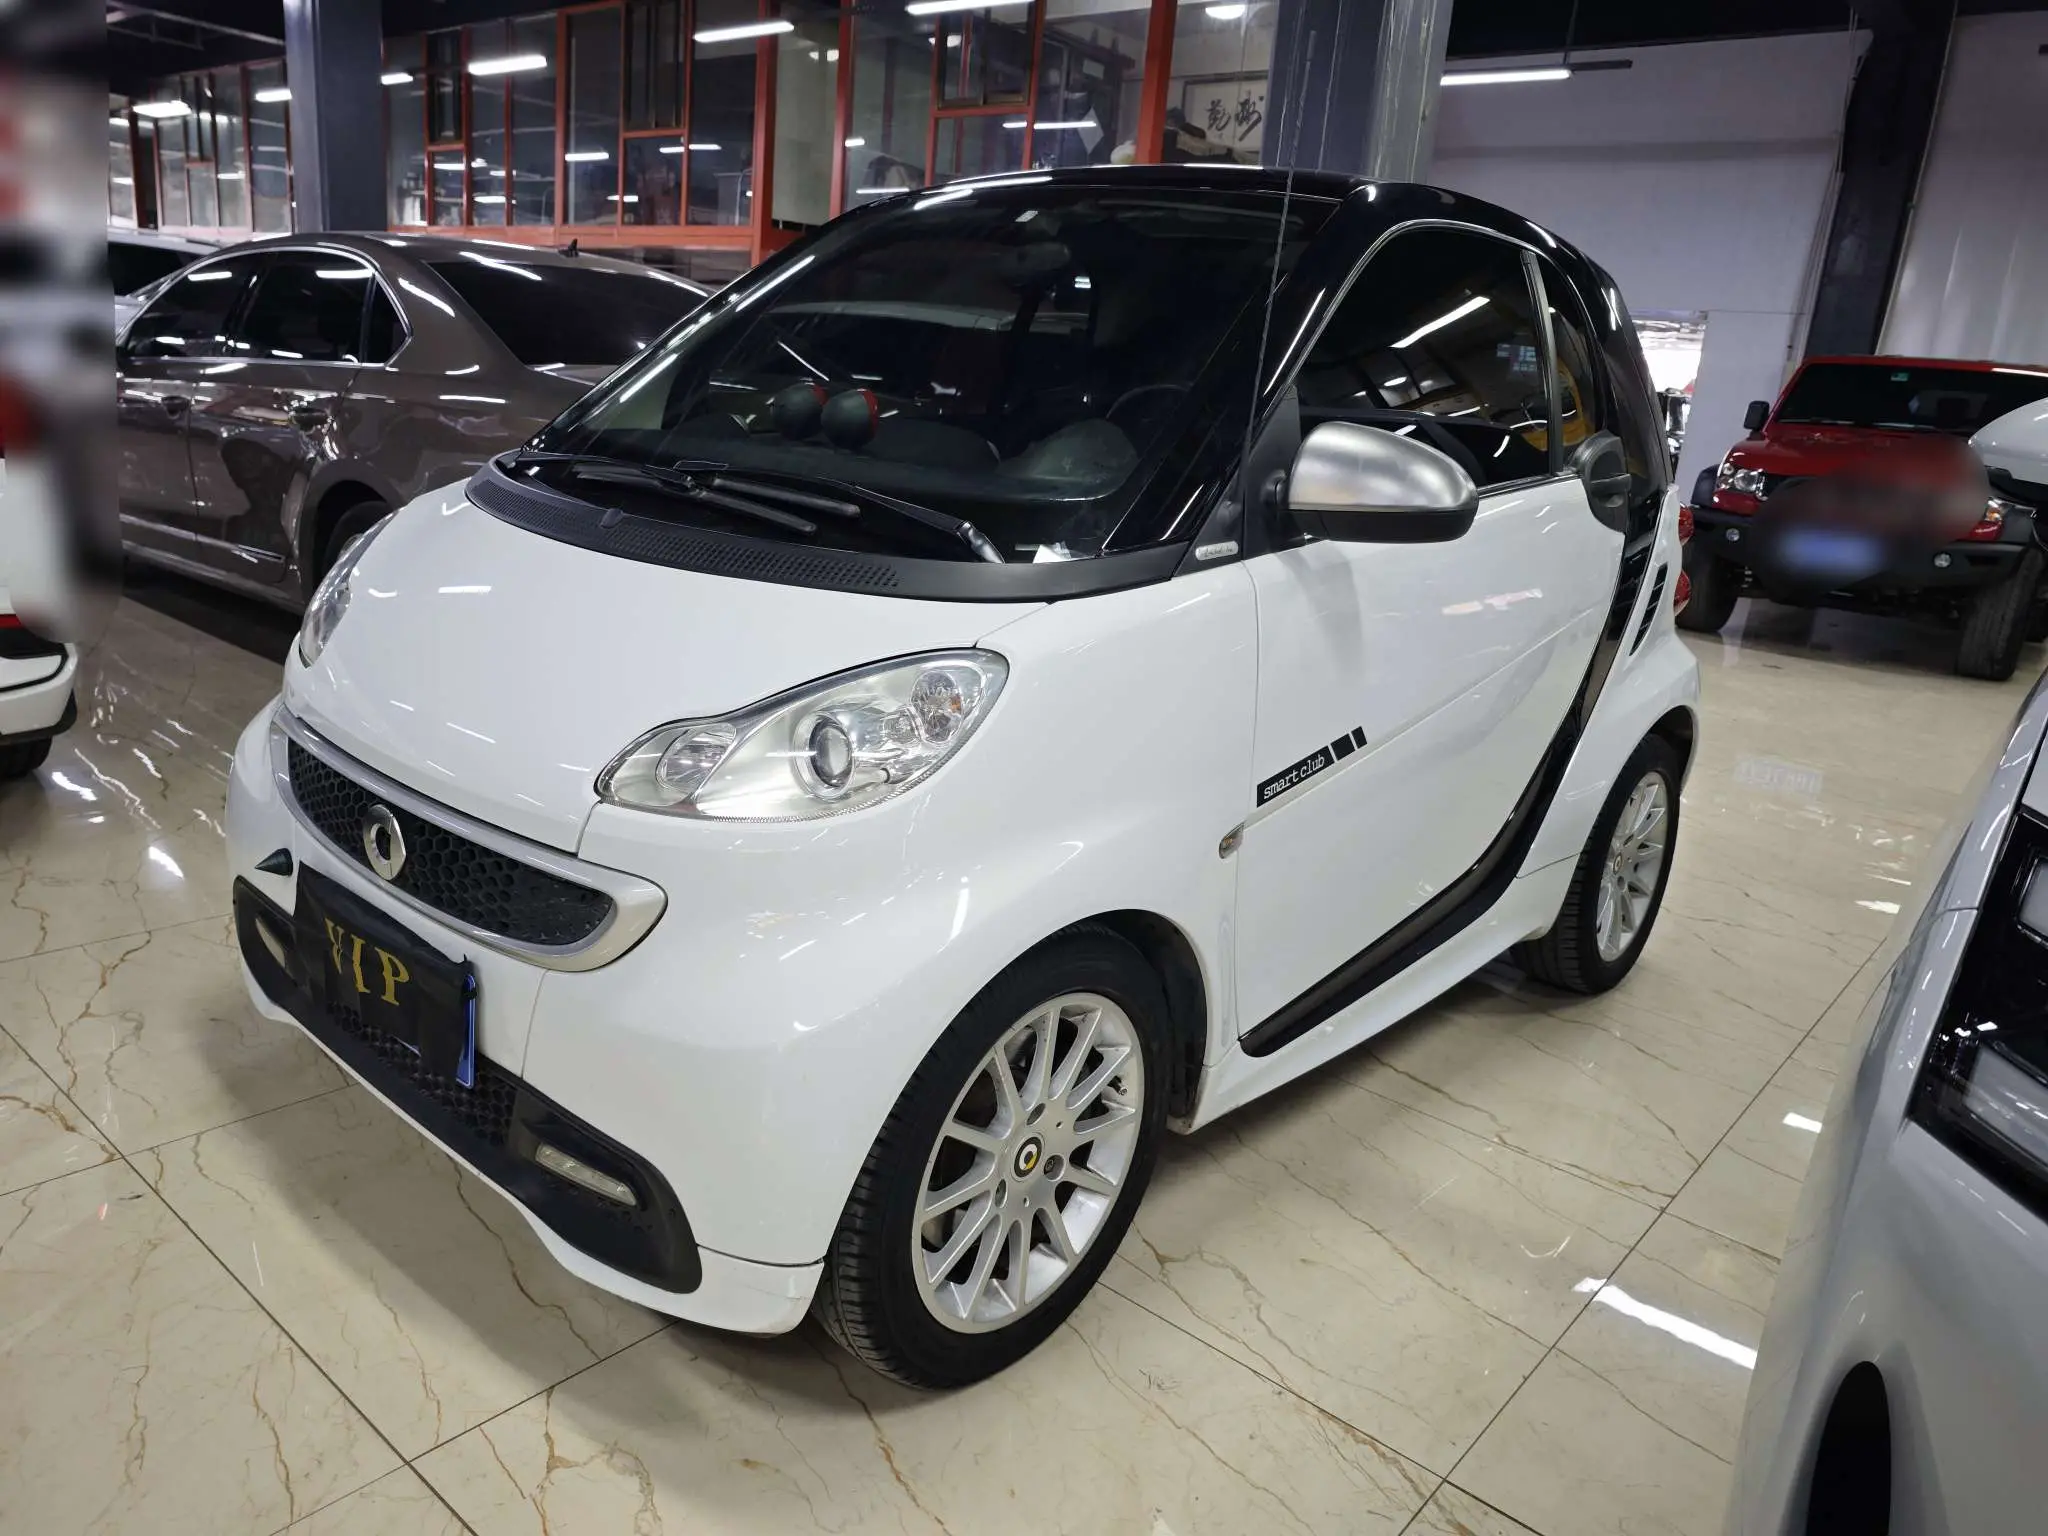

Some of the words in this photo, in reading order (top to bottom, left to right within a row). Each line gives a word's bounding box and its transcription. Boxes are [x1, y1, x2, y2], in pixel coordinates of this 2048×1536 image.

[1263, 771, 1300, 800] smart
[1299, 753, 1326, 778] club
[324, 917, 411, 1006] VIP
